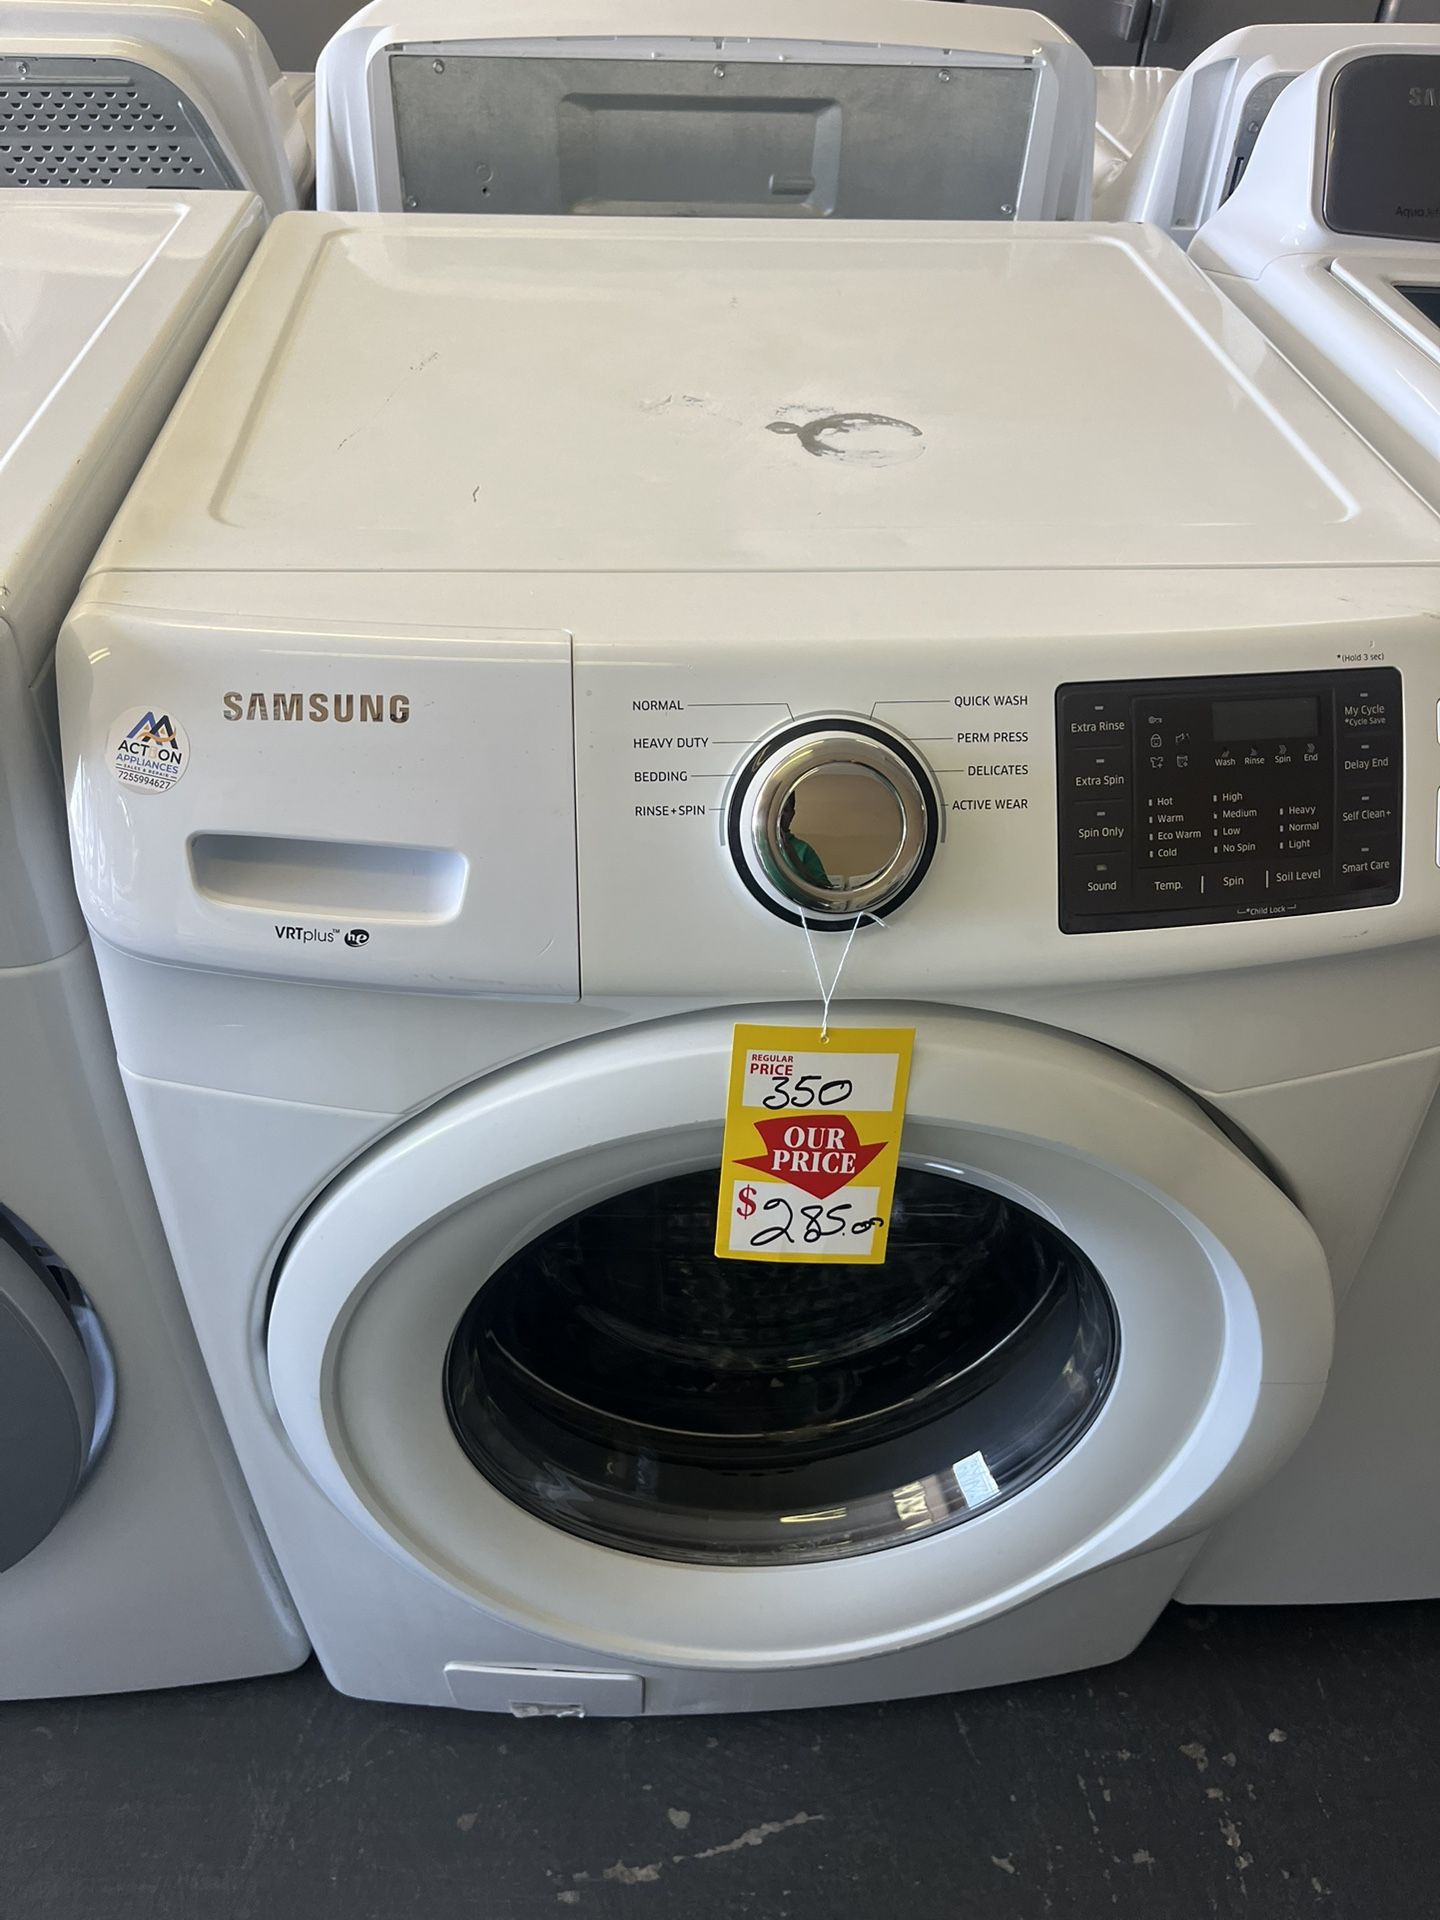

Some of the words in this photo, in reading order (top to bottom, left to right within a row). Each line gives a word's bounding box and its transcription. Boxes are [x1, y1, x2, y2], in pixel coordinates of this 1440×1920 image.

[1408, 87, 1440, 107] SA
[1363, 653, 1369, 661] 3
[1370, 652, 1385, 661] sec)
[632, 700, 684, 711] NORMAL
[954, 696, 990, 707] QUICK
[993, 695, 1028, 706] WASH
[223, 691, 410, 724] SAMSUNG
[1344, 706, 1359, 717] My
[1361, 704, 1385, 715] Cycle
[1369, 716, 1386, 725] Save
[1071, 722, 1097, 733] Extra
[1099, 721, 1125, 732] Rinse
[633, 738, 673, 748] HEAVY
[677, 737, 709, 748] DUTY
[957, 733, 990, 743] PERM
[993, 732, 1029, 742] PRESS
[1215, 757, 1236, 767] Wash
[1244, 756, 1265, 765] Rinse
[1274, 755, 1291, 764] Spin
[1303, 753, 1319, 762] End
[116, 753, 179, 774] APPLIANCES
[1344, 759, 1370, 771] Delay
[1372, 757, 1389, 768] End
[968, 765, 1029, 776] DELICATES
[118, 770, 171, 790] 7255994627
[634, 771, 688, 782] BEDDING
[1075, 777, 1101, 787] Extra
[1104, 775, 1125, 786] Spin
[1157, 797, 1174, 806] Hot
[1222, 792, 1243, 803] High
[952, 800, 991, 810] ACTIVE
[995, 799, 1028, 809] WEAR
[635, 805, 706, 816] RINSE+SPIN
[1222, 809, 1257, 819] Medium
[1288, 805, 1316, 816] Heavy
[1157, 814, 1184, 823] Warm
[1342, 811, 1359, 822] Self
[1222, 827, 1241, 836] Low
[1288, 822, 1320, 832] Normal
[1078, 828, 1100, 839] Spin
[1102, 827, 1125, 838] Only
[1157, 831, 1174, 840] Eco
[1175, 829, 1202, 839] Warm
[1222, 844, 1236, 853] No
[1237, 842, 1256, 853] Spin
[1288, 839, 1311, 850] Light
[1157, 848, 1177, 857] Cold
[1342, 862, 1368, 873] Smart
[1370, 860, 1390, 870] Care
[1223, 875, 1245, 887] Spin
[1276, 871, 1294, 882] Soil
[1296, 869, 1321, 880] Level
[1087, 881, 1117, 891] Sound
[1154, 880, 1184, 891] Temp.
[1269, 905, 1286, 914] Lock
[751, 1053, 794, 1063] REGULAR
[750, 1063, 794, 1076] PRICE
[763, 1076, 853, 1110] 350
[783, 1126, 846, 1150] OUR
[771, 1150, 857, 1174] PRICE
